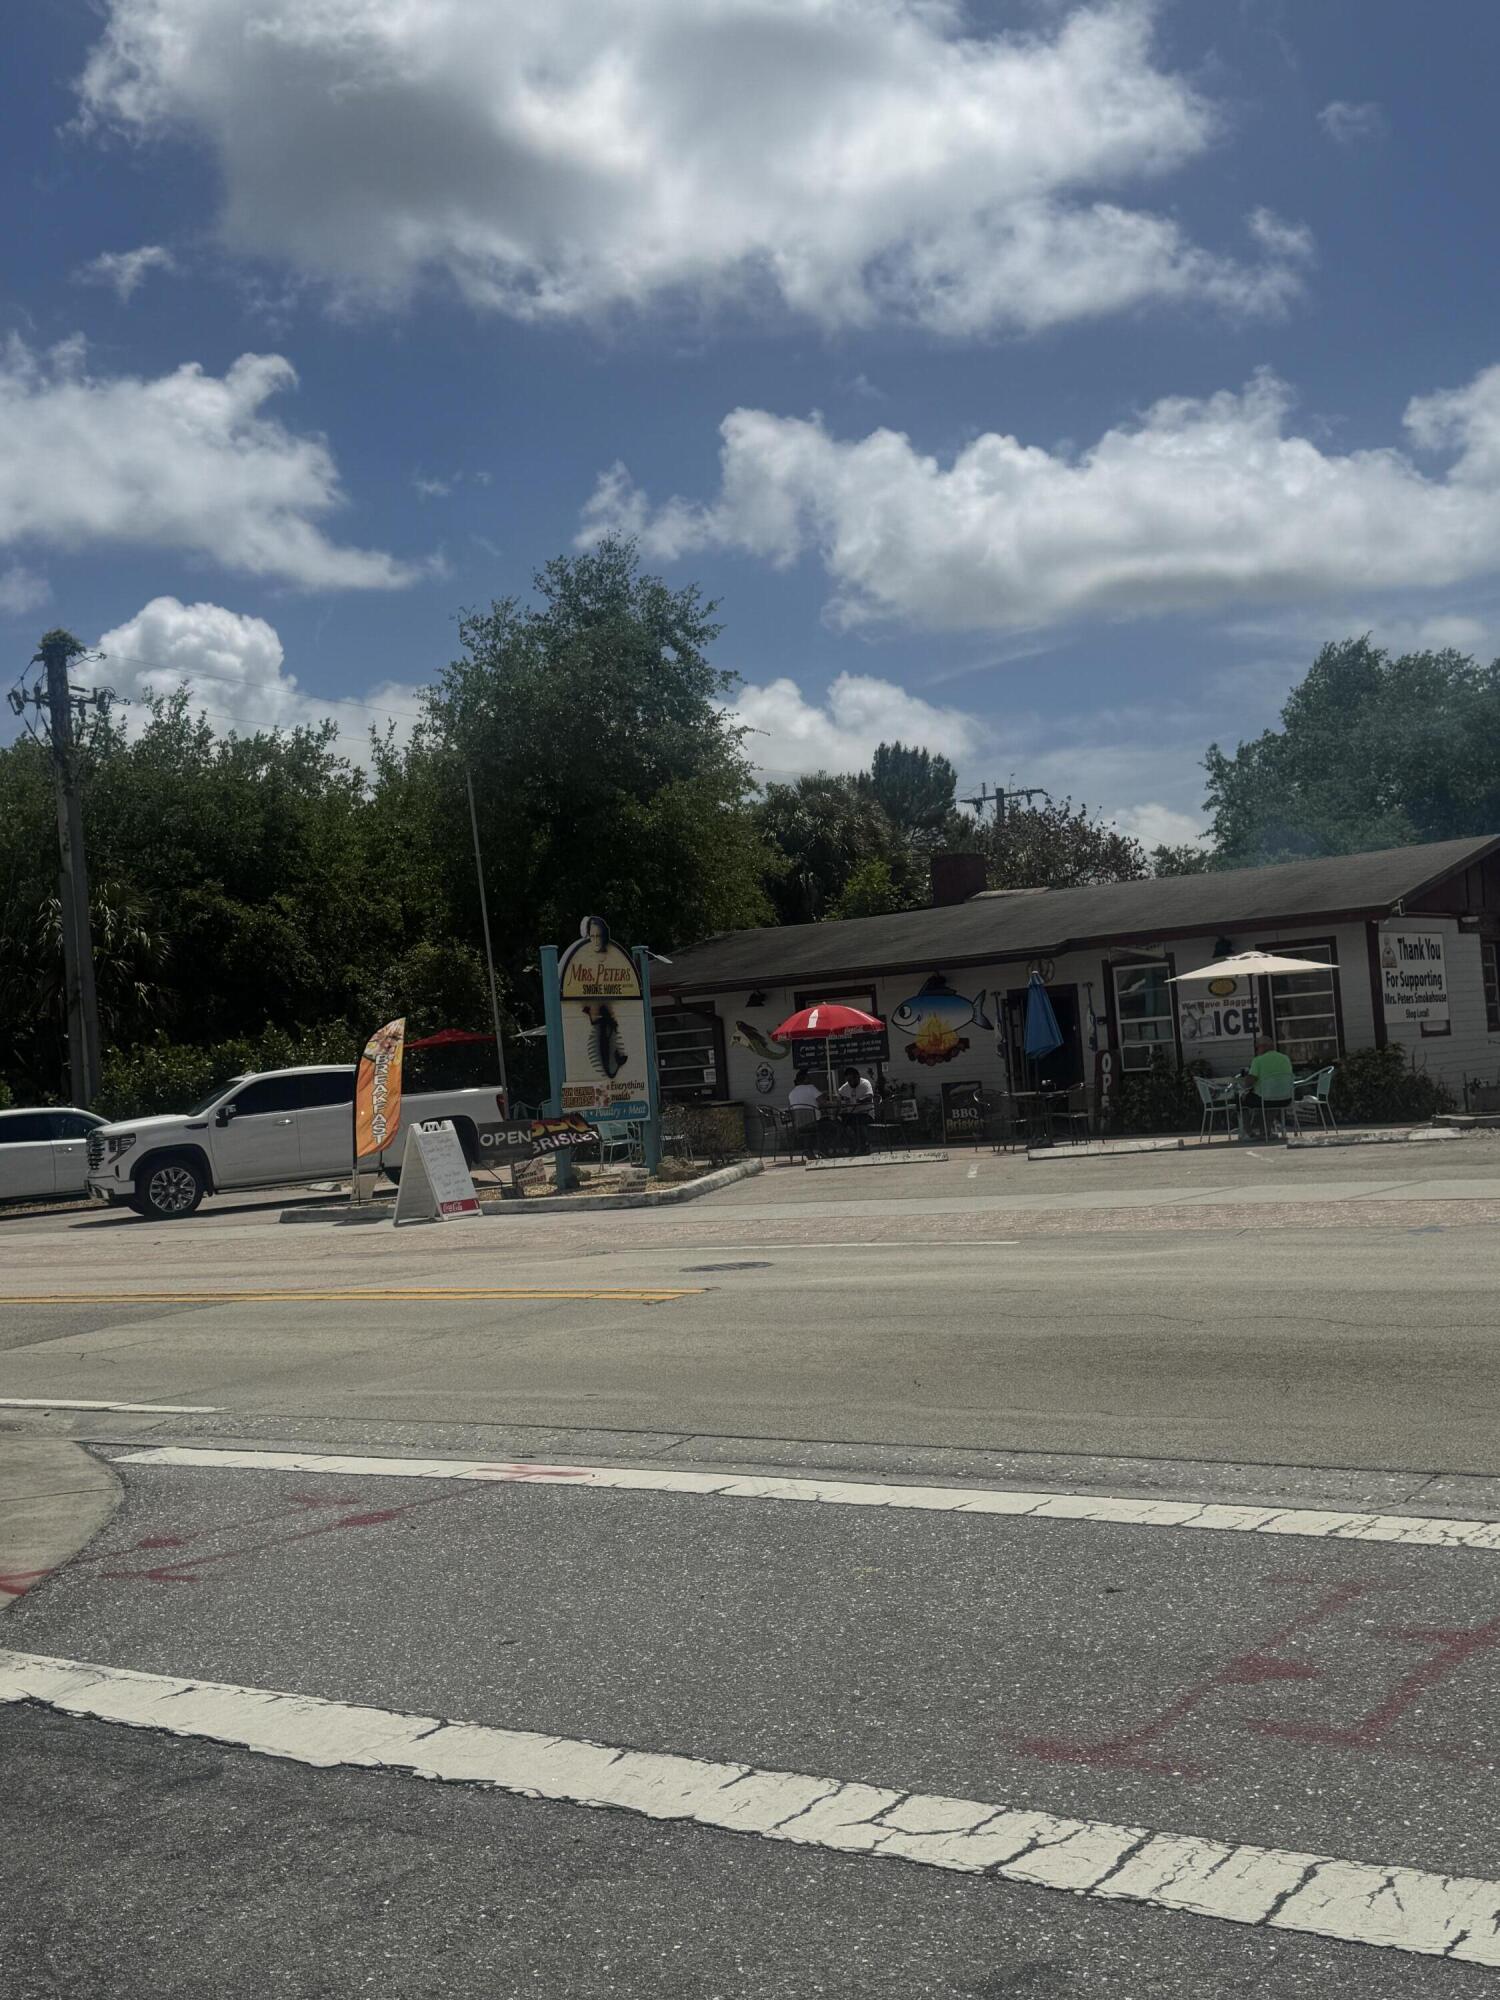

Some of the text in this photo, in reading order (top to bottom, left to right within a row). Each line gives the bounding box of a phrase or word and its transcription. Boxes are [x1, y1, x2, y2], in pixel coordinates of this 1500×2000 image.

[1397, 936, 1441, 960] Thank You
[1385, 969, 1442, 991] For Supporting
[582, 983, 603, 995] SMOKE
[603, 983, 622, 995] HOUSE
[1384, 991, 1447, 1004] Mrs. Peters Smokehouse
[1213, 1008, 1260, 1036] ICE
[1405, 1008, 1416, 1019] Shop
[372, 1054, 389, 1144] BREAKFAST
[629, 1104, 646, 1114] Meat
[951, 1107, 979, 1119] BBQ
[479, 1130, 532, 1147] OPEN
[532, 1131, 600, 1154] BRISKET
